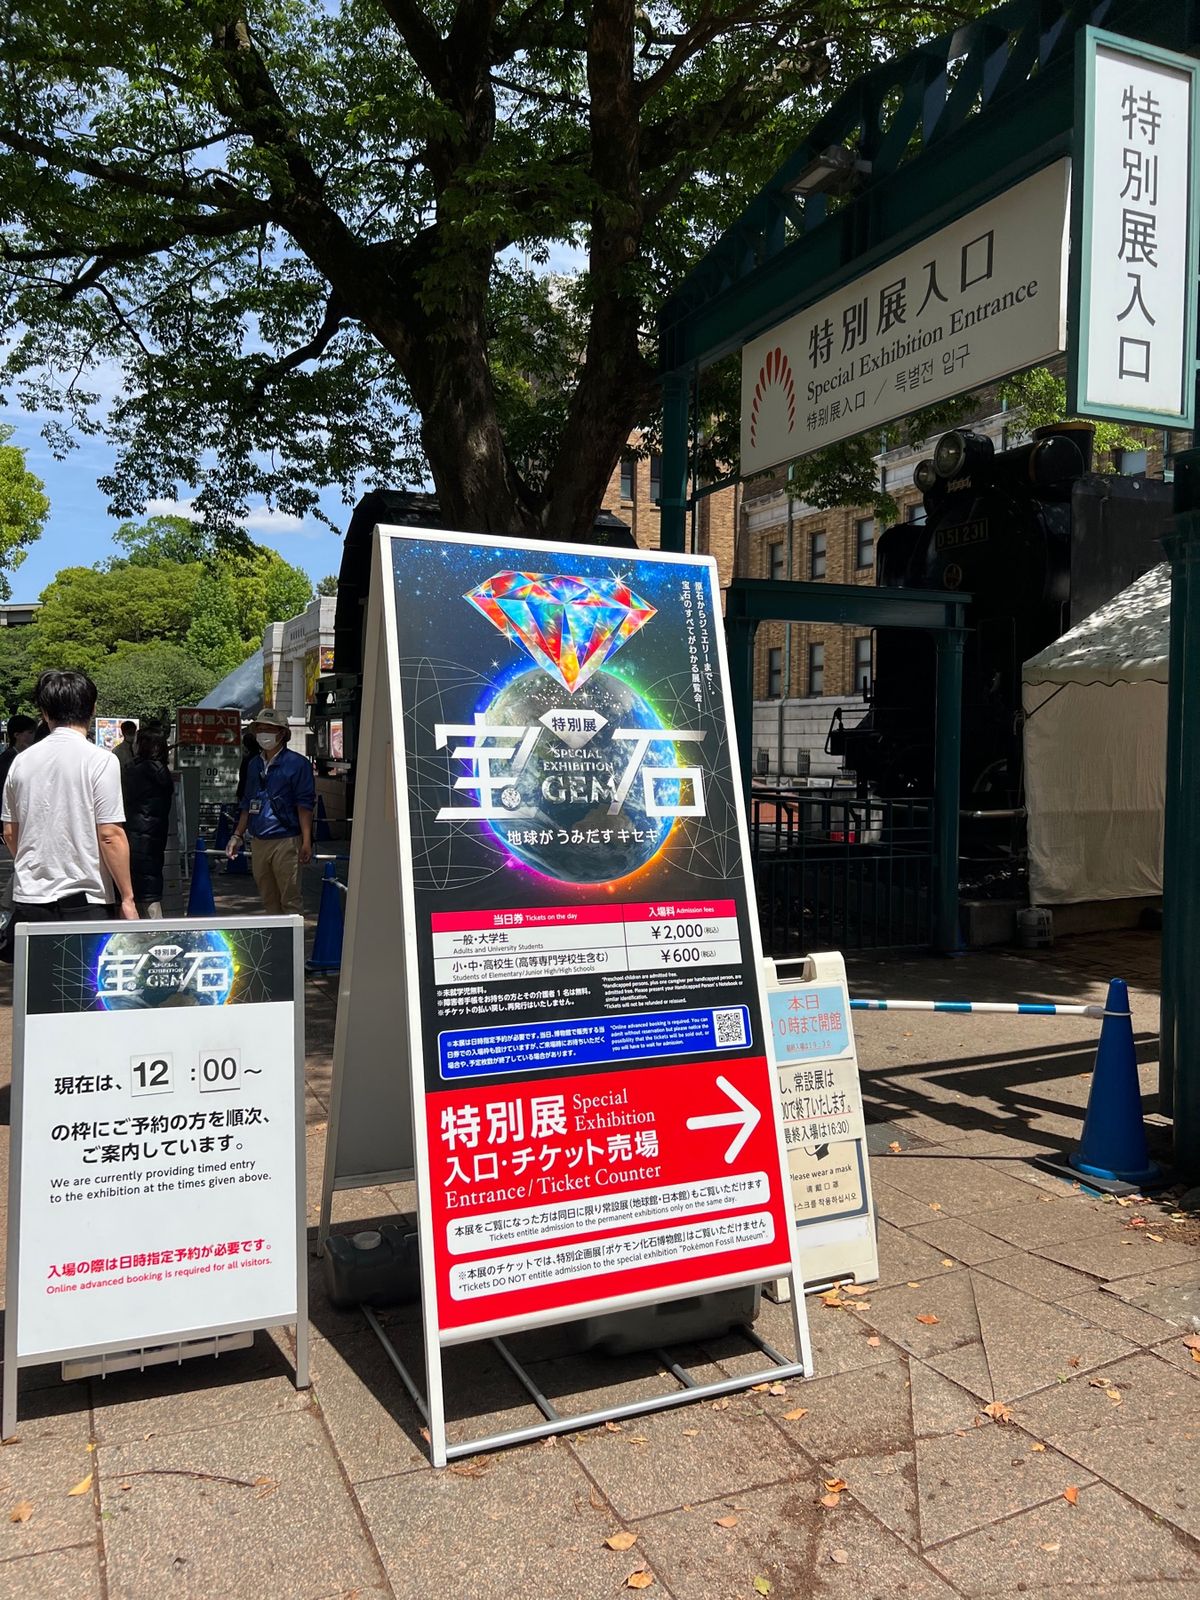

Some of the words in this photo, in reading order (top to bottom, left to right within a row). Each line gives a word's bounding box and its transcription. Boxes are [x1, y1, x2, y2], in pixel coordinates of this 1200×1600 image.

[1117, 85, 1161, 382] 特別展入口
[809, 230, 994, 368] 特別展入口
[808, 359, 854, 403] Special
[859, 327, 942, 377] Exhibition
[949, 280, 1038, 336] Entrance
[807, 391, 865, 432] 特别展入口
[895, 358, 933, 392] 특별전
[942, 343, 970, 376] 입구
[552, 716, 597, 732] 特別展
[434, 713, 707, 821] 宝石
[544, 761, 613, 772] EXHIBITION
[554, 749, 602, 759] SPECIAL
[542, 776, 619, 803] GEM
[494, 914, 523, 925] 当日券
[649, 906, 675, 916] 入場料
[453, 932, 508, 945] 一般・大学生
[96, 950, 230, 997] 宝石
[146, 974, 184, 987] GEM
[788, 994, 819, 1011] 本日
[133, 1060, 169, 1087] 12
[573, 1088, 627, 1112] Special
[52, 1107, 270, 1141] の枠にご予約の方を順次、
[441, 1095, 568, 1150] 特別展
[575, 1110, 655, 1131] Exhibition
[82, 1134, 242, 1164] ご案内しています。
[51, 1179, 69, 1188] We
[74, 1178, 90, 1186] are
[95, 1171, 142, 1183] currently
[146, 1166, 194, 1181] providing
[198, 1162, 226, 1173] timed
[230, 1160, 255, 1170] entry
[537, 1174, 590, 1194] Ticket
[595, 1166, 661, 1185] Counter
[835, 1164, 852, 1173] mask
[50, 1195, 61, 1203] to
[66, 1192, 83, 1201] the
[87, 1186, 140, 1199] exhibition
[144, 1184, 154, 1192] at
[158, 1182, 174, 1191] the
[178, 1180, 205, 1189] times
[209, 1176, 235, 1188] given
[239, 1174, 271, 1182] above.
[489, 1232, 514, 1241] Tickets
[517, 1228, 538, 1237] entitle
[541, 1222, 574, 1233] admission
[598, 1212, 632, 1225] permanent
[634, 1207, 668, 1217] exhibitions
[48, 1239, 271, 1278] 入場の際は日時指定予約が必要です。
[493, 1278, 506, 1286] DO
[508, 1274, 526, 1284] NOT
[529, 1269, 552, 1280] entitle
[555, 1264, 591, 1275] admission
[603, 1258, 615, 1266] the
[617, 1253, 642, 1265] special
[644, 1248, 677, 1259] exhibition
[715, 1237, 734, 1246] Fossil
[47, 1284, 77, 1294] Online
[80, 1277, 124, 1289] advanced
[127, 1273, 162, 1283] booking
[175, 1264, 210, 1277] required
[228, 1261, 238, 1269] all
[241, 1258, 272, 1267] visitors.
